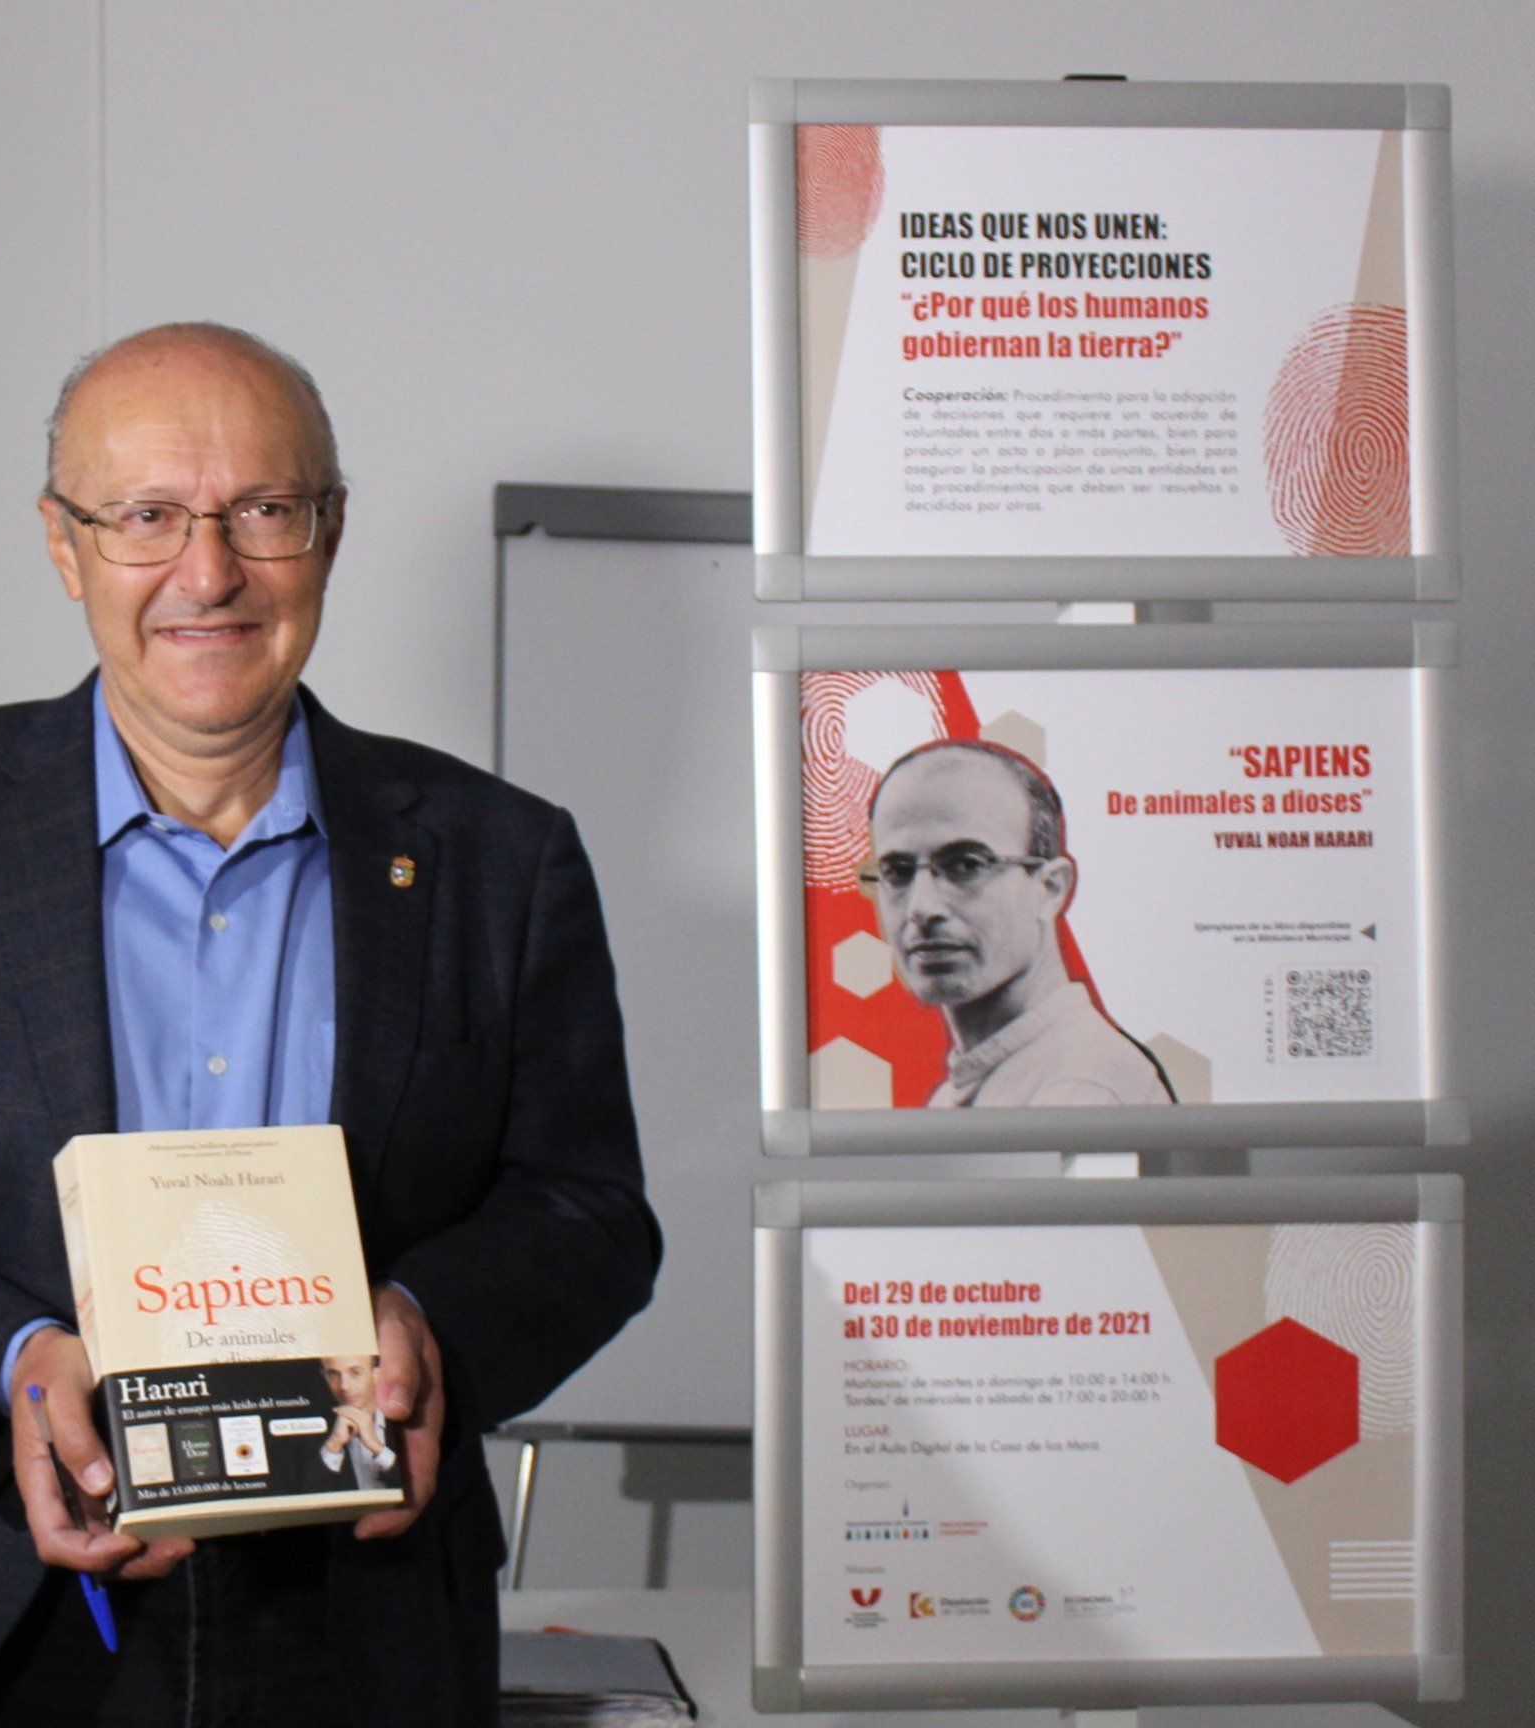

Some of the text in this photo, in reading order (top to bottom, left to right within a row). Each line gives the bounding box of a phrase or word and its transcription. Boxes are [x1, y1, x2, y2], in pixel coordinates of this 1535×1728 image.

[900, 212, 1168, 243] IDEAS QUE NOS UNEN:
[901, 253, 1211, 280] CICLO DE PROYECCIONES
[982, 291, 1031, 321] qué
[1038, 292, 1077, 318] los
[1085, 292, 1209, 318] humanos
[902, 332, 1042, 361] gobiernan
[1048, 332, 1072, 358] la
[903, 387, 1008, 404] Cooperación:
[1229, 744, 1371, 778] “SAPIENS
[1107, 791, 1137, 815] De
[1144, 790, 1256, 815] animales
[1262, 793, 1275, 813] a
[1214, 831, 1373, 848] YUVAL NOAH HARARI
[150, 1171, 285, 1190] Yuval Noah Harari
[134, 1264, 335, 1326] Sapiens
[844, 1281, 1041, 1304] Del 29 de octubre
[844, 1312, 1151, 1338] al 30 de noviembre de 2021
[186, 1329, 296, 1349] De animales
[118, 1374, 210, 1403] Harari
[122, 1409, 136, 1421] El
[136, 1407, 162, 1418] autor
[164, 1405, 176, 1417] de
[178, 1405, 210, 1416] ensayo
[213, 1402, 231, 1412] más
[259, 1398, 274, 1410] del
[276, 1396, 310, 1407] mundo
[137, 1489, 156, 1500] Más
[159, 1487, 171, 1498] de
[222, 1481, 233, 1493] de
[234, 1480, 268, 1492] lectores
